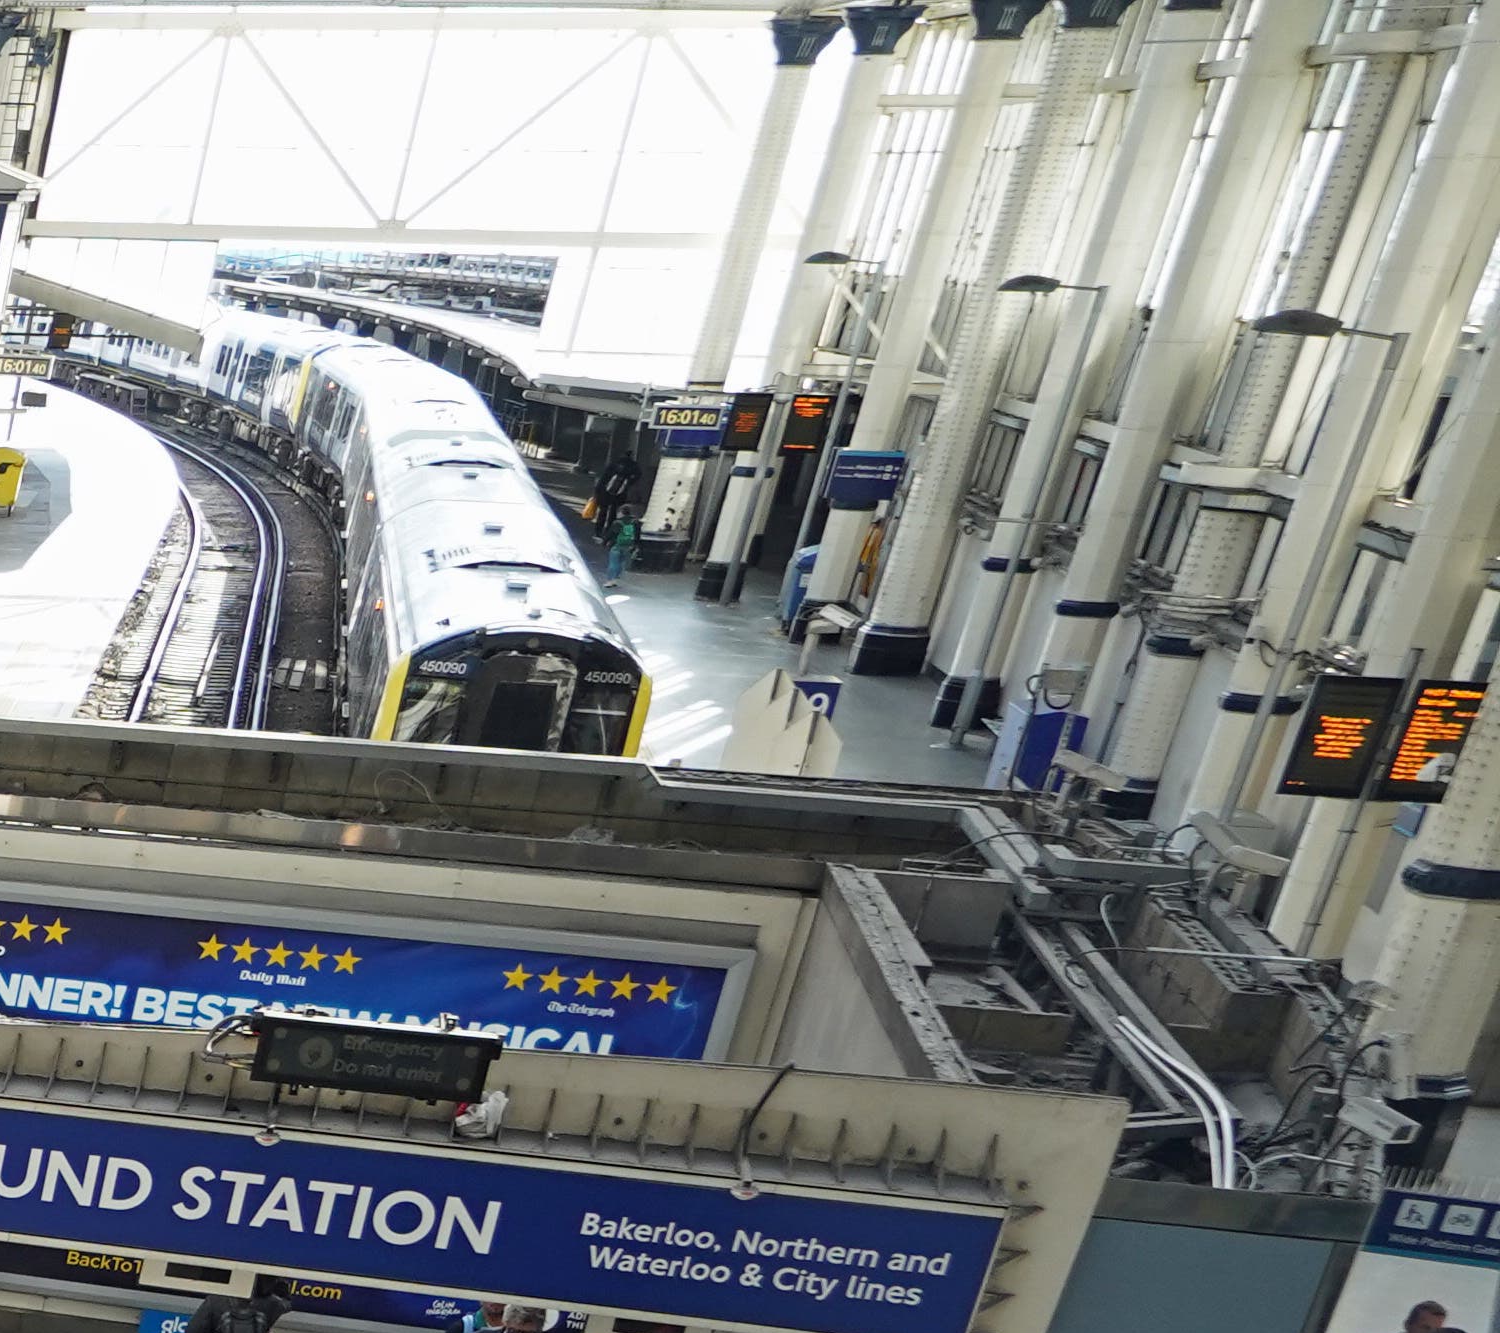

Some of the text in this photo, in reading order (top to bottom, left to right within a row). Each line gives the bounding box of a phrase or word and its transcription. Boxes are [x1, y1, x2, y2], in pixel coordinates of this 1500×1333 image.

[659, 409, 699, 425] 16:01
[699, 413, 717, 425] 40
[419, 660, 467, 674] 450090
[584, 671, 632, 684] 450090
[239, 970, 306, 987] Daily Mail
[131, 986, 260, 1029] BEST
[567, 1001, 616, 1018] Telegraph
[342, 1034, 445, 1060] Emergency
[332, 1059, 360, 1074] Do
[396, 1067, 443, 1083] enter
[173, 1165, 504, 1257] STATION
[580, 1212, 952, 1276] Bakerloo, Northern and
[589, 1245, 923, 1307] Waterloo & City lines
